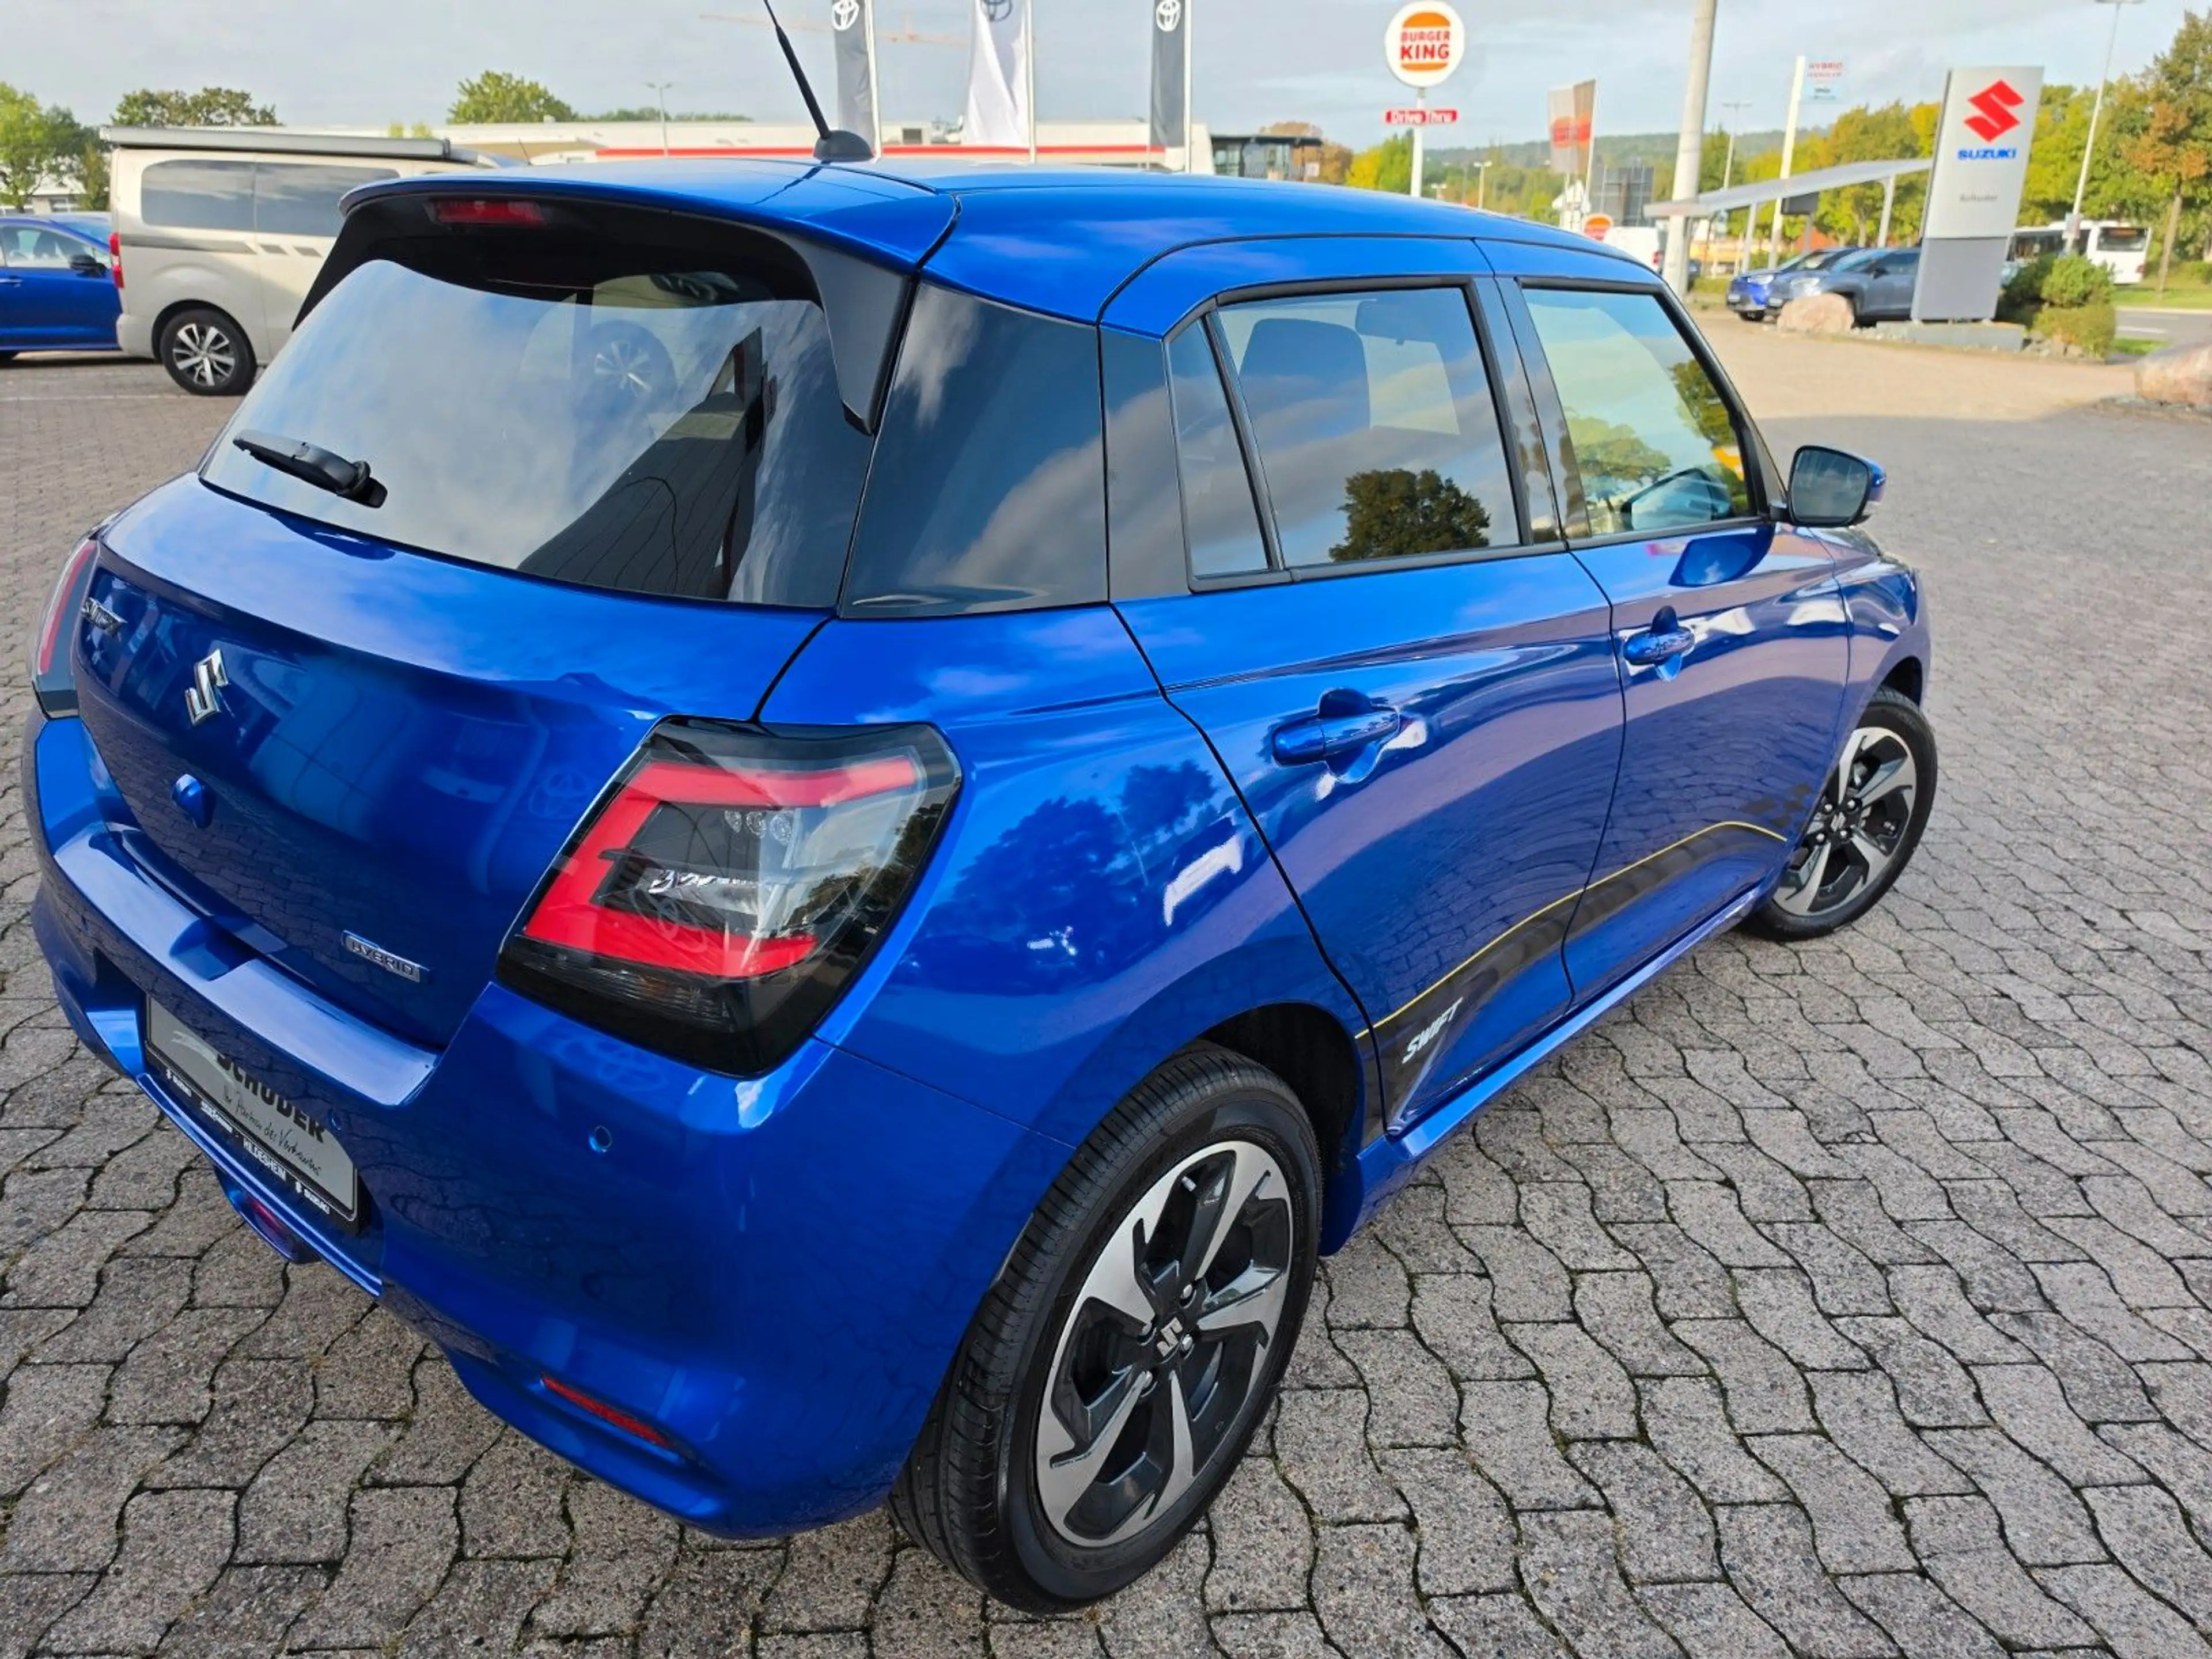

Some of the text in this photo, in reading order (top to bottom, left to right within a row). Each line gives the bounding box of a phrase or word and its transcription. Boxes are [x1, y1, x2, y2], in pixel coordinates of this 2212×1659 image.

[1401, 31, 1450, 41] BURGER
[1400, 44, 1450, 60] KING
[1957, 148, 2017, 160] SUZUKI
[351, 940, 414, 975] HYBRID
[1402, 996, 1464, 1065] SWIFT
